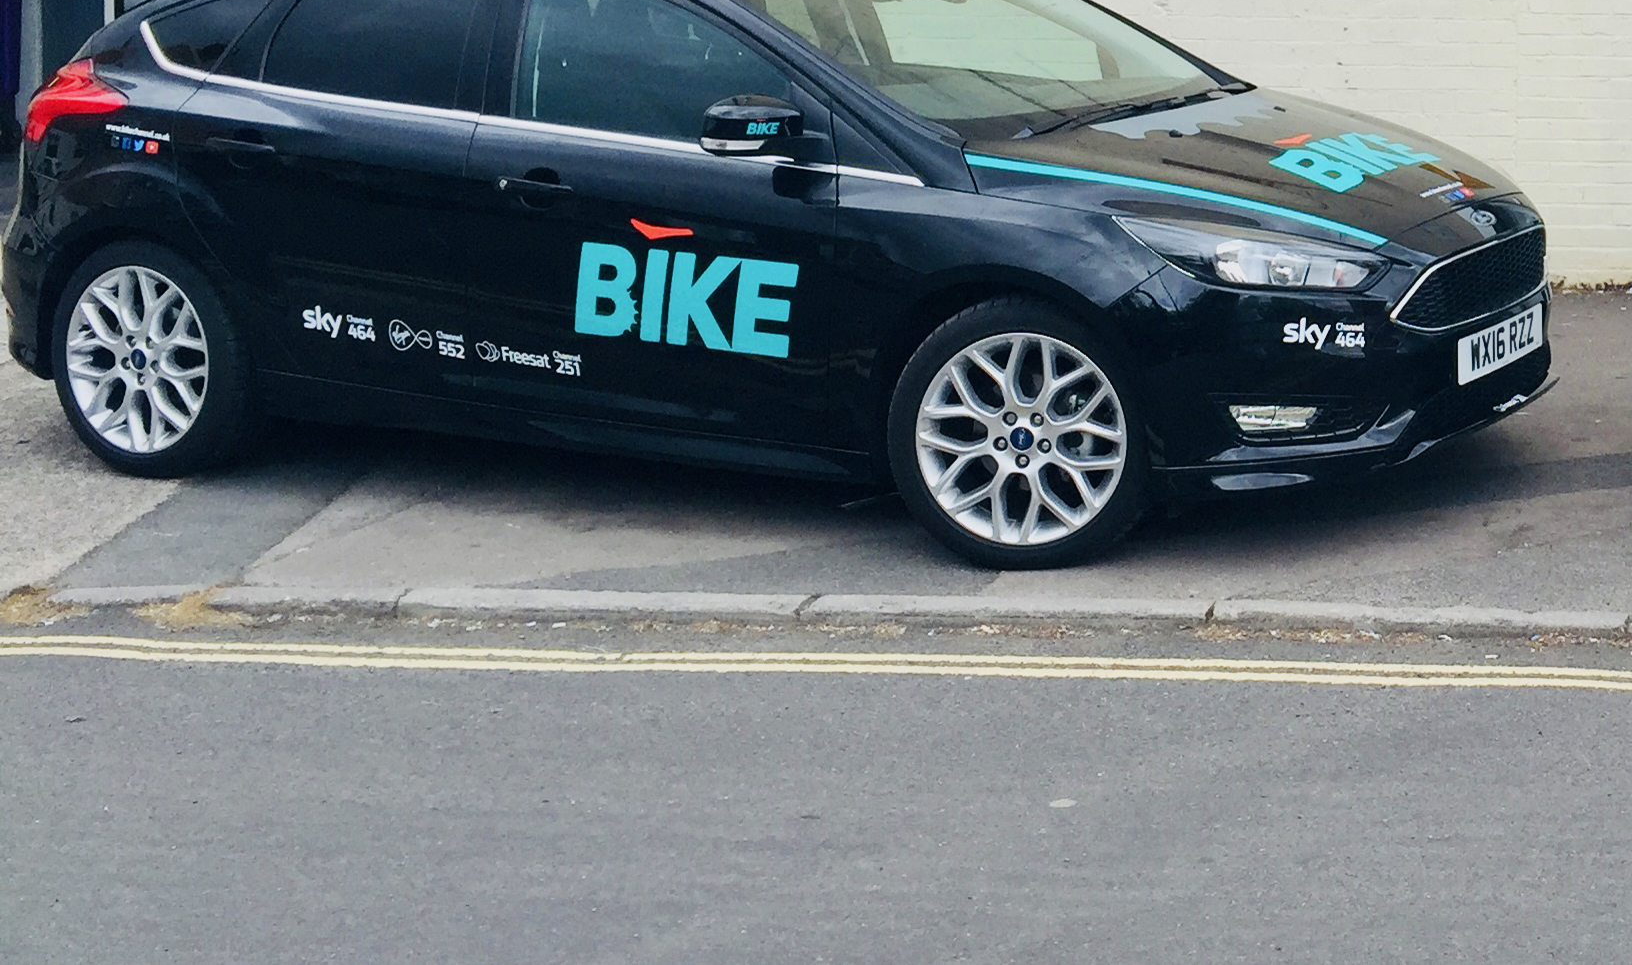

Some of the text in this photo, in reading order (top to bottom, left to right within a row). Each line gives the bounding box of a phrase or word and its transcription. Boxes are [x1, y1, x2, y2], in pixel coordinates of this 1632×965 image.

[746, 121, 780, 135] BIKE
[1269, 131, 1441, 193] BIKE
[574, 241, 799, 358] BIKE
[302, 305, 342, 338] sky
[1335, 322, 1365, 332] Channel
[347, 324, 376, 342] 464
[1283, 317, 1331, 351] sky
[1335, 332, 1366, 348] 464
[1470, 311, 1534, 372] WX16 RZZ
[438, 341, 466, 360] 552
[501, 346, 551, 369] Freesat
[554, 359, 582, 376] 251
